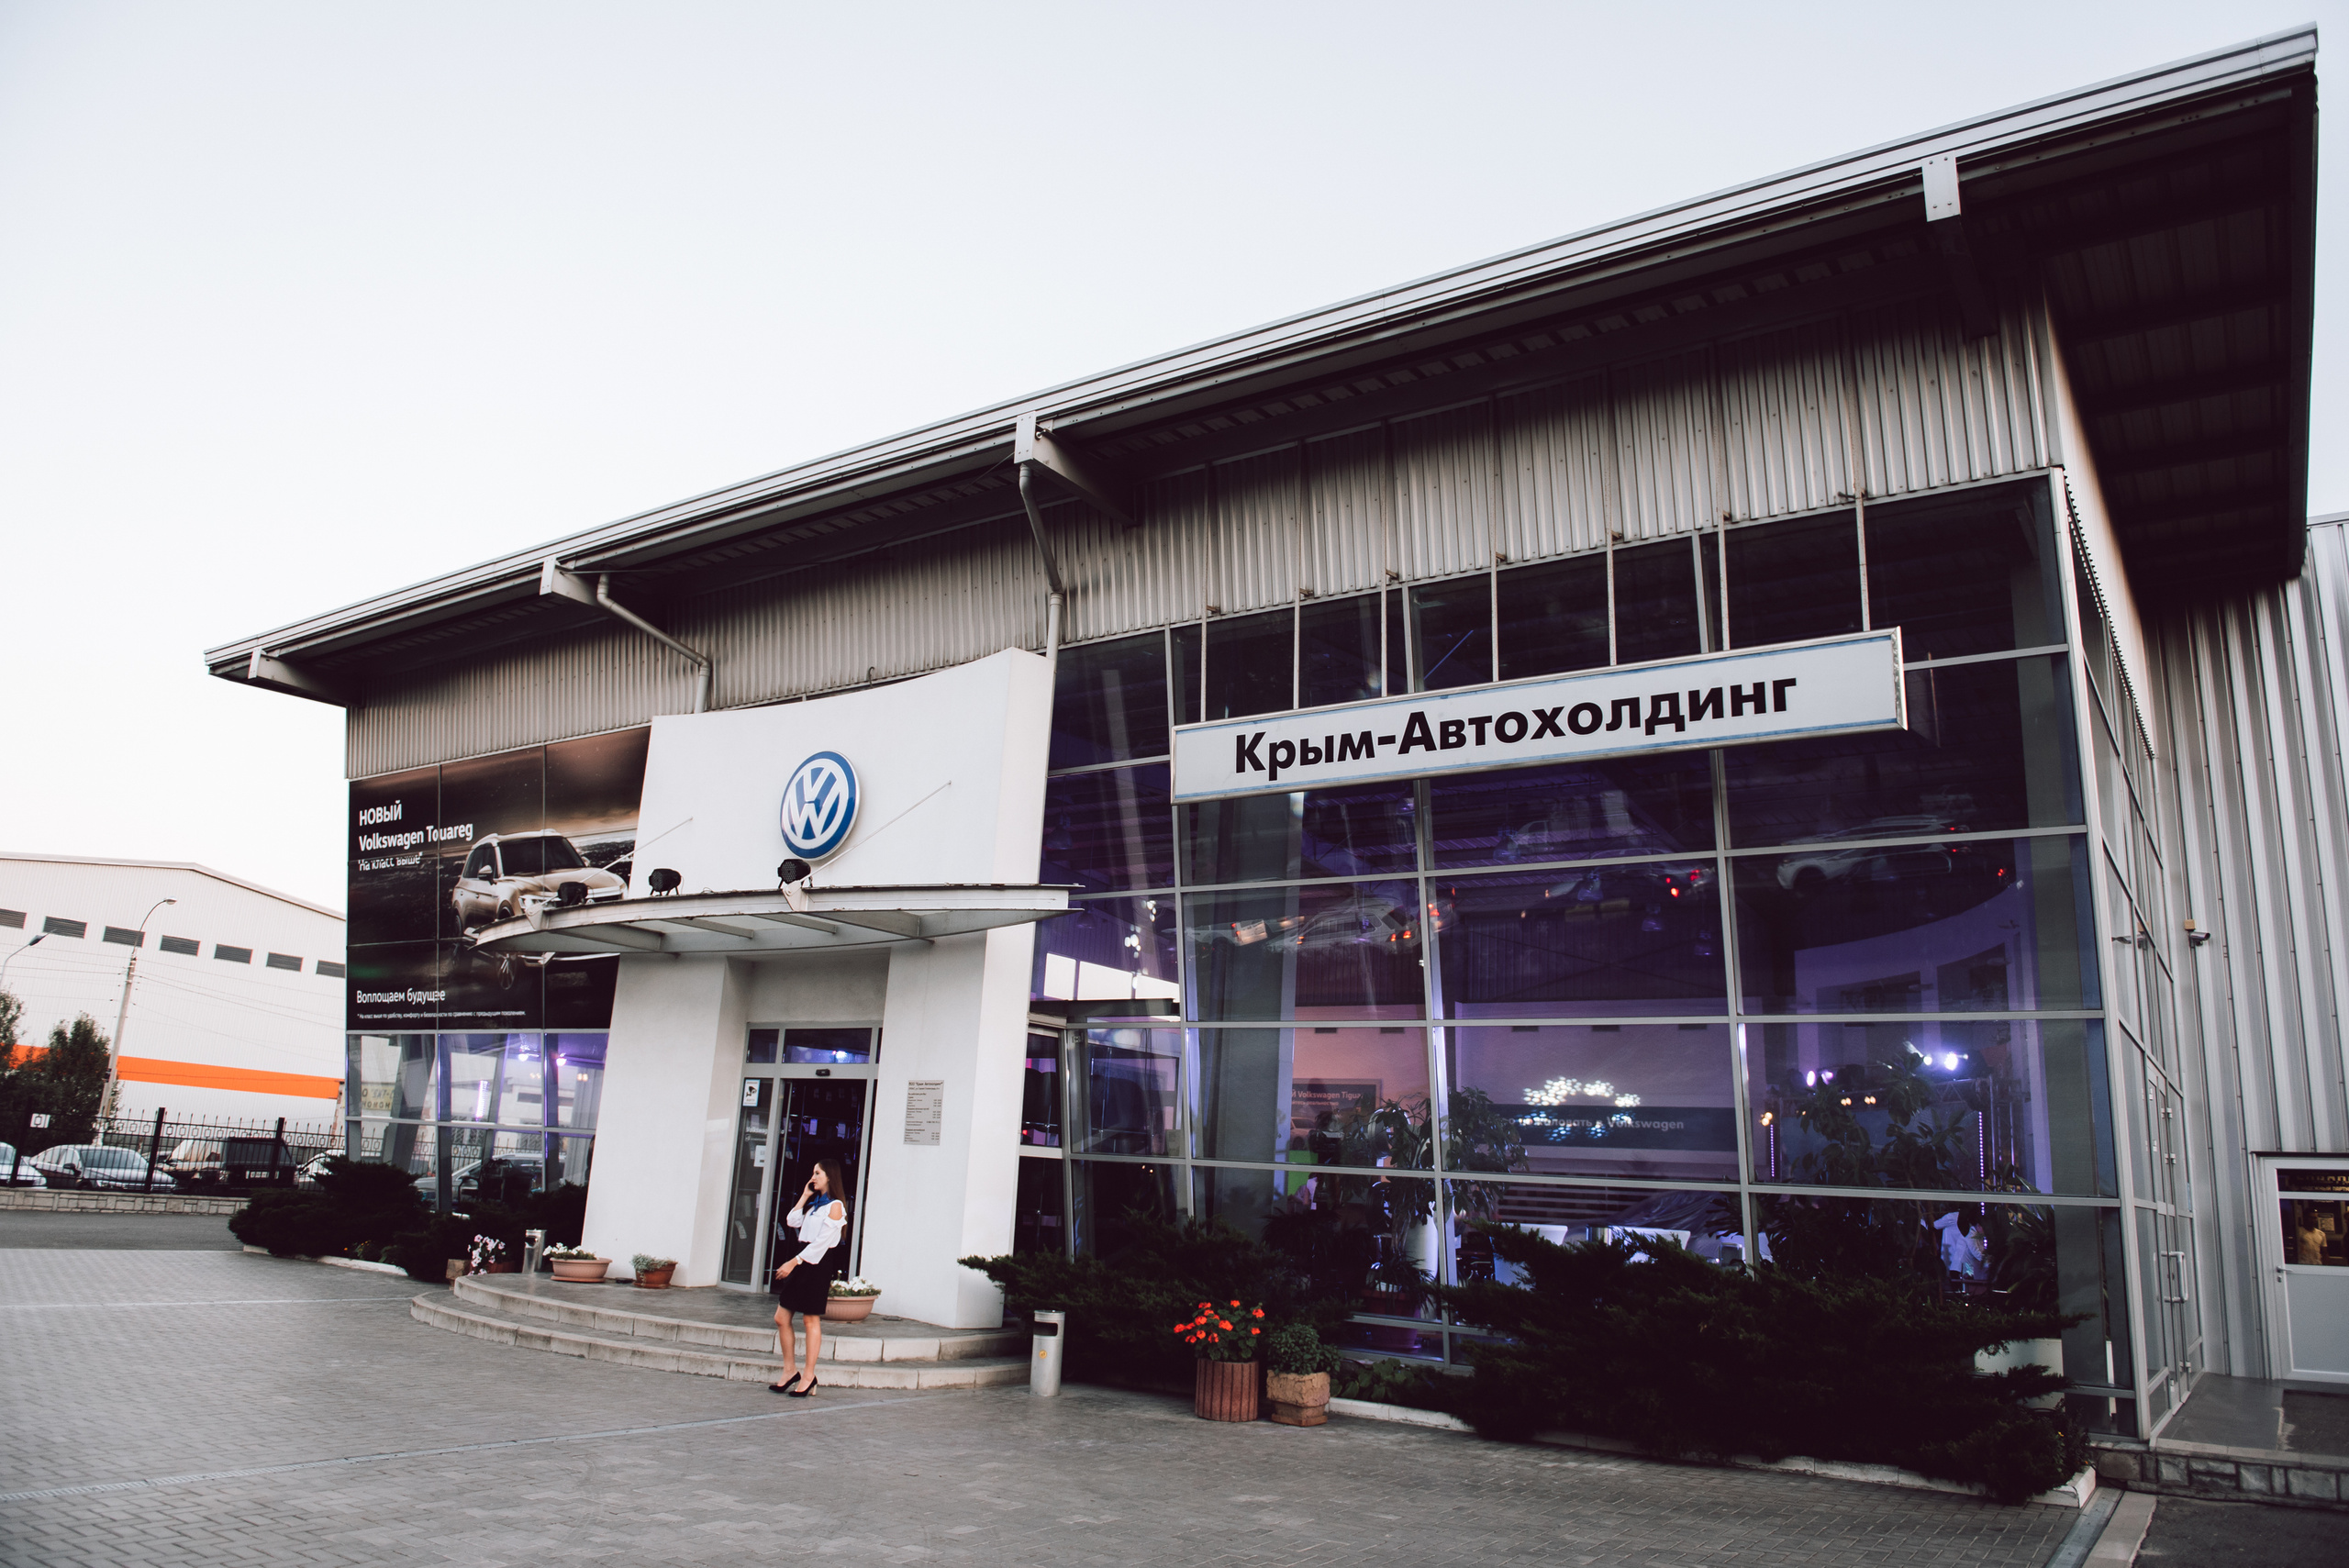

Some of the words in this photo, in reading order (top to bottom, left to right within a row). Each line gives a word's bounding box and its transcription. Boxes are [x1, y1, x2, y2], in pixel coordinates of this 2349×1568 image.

[1235, 677, 1798, 782] Крым-Автохолдинг
[359, 799, 403, 827] НОВЫЙ
[359, 830, 424, 851] Volkswagen
[426, 823, 473, 841] Touareg
[356, 990, 406, 1005] Воплощаем
[406, 987, 446, 1006] будущее
[1297, 1090, 1340, 1100] Volkswagen
[1341, 1091, 1364, 1100] Tigua
